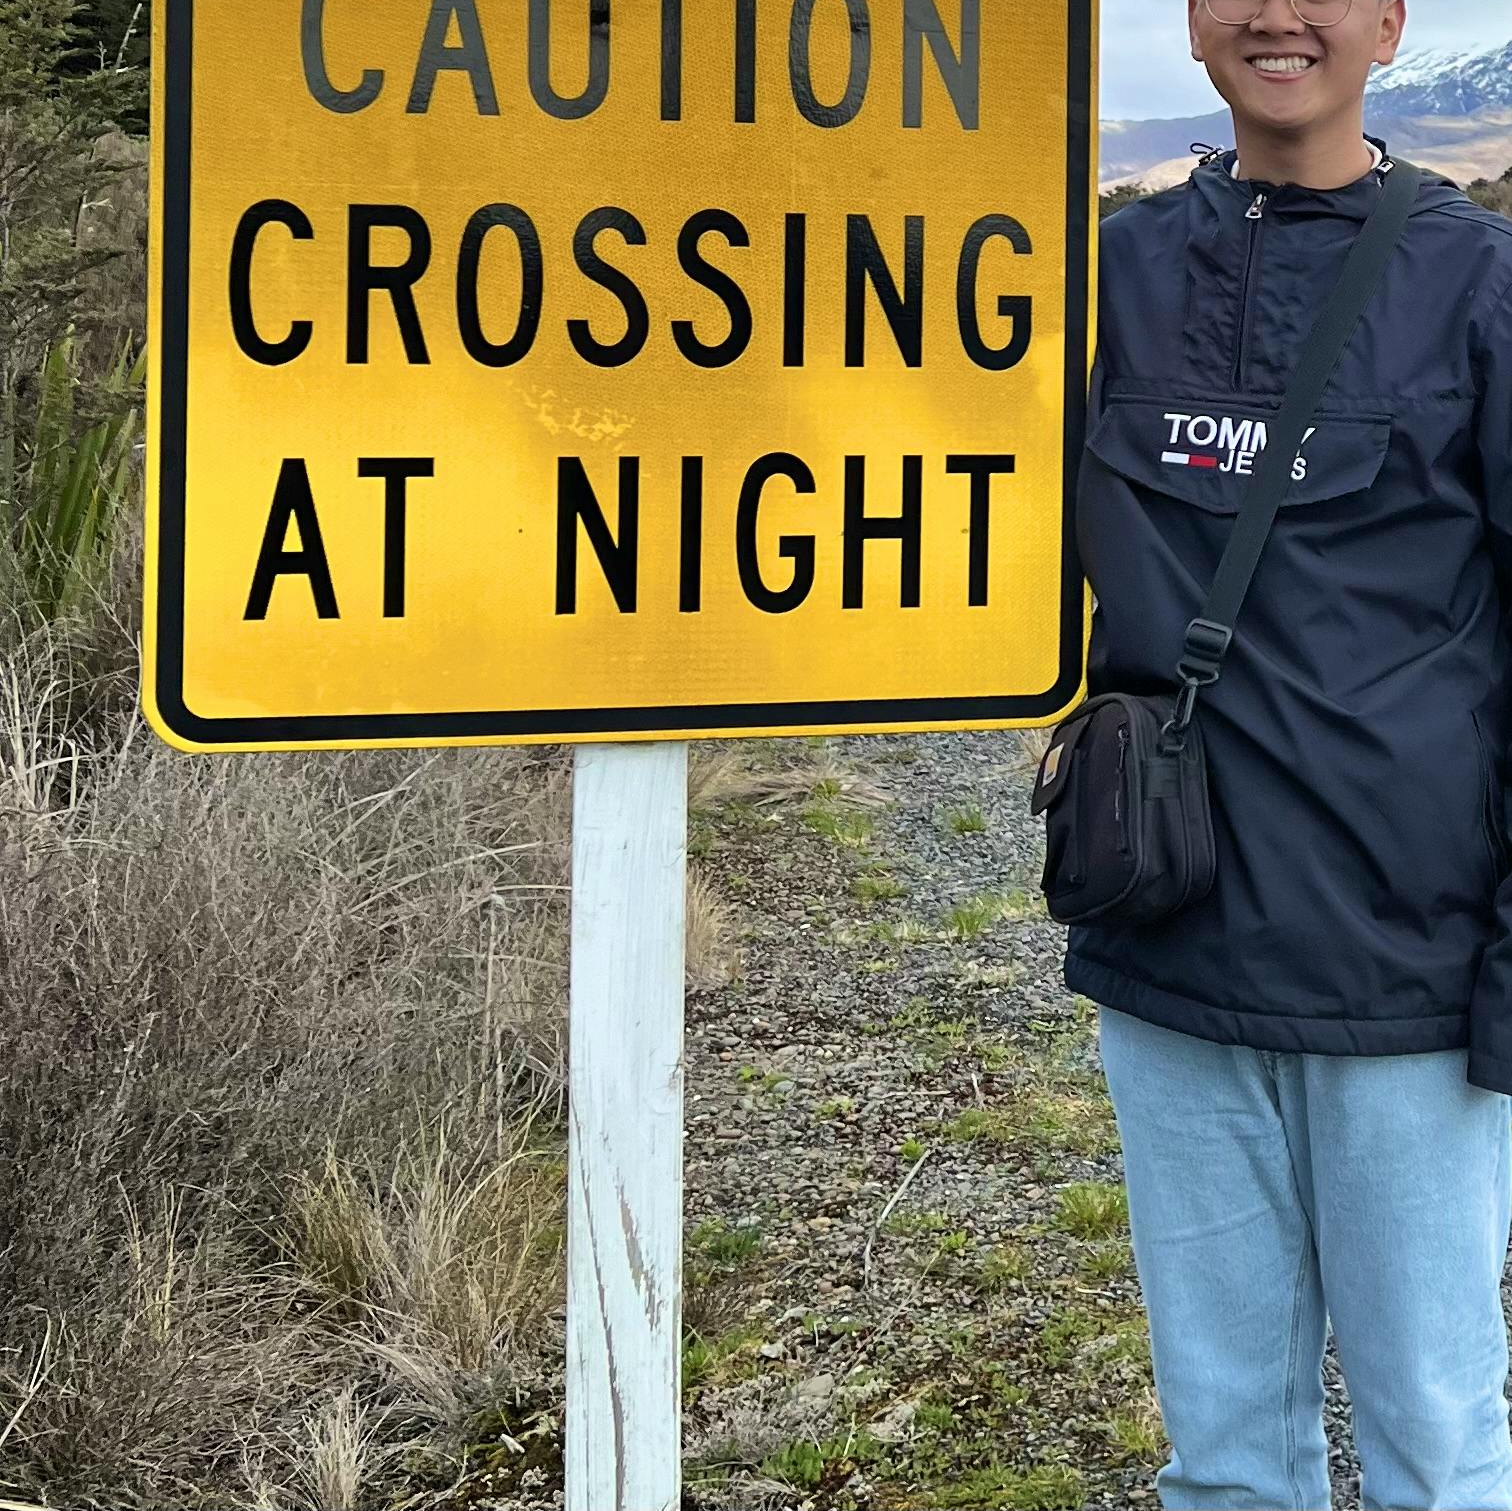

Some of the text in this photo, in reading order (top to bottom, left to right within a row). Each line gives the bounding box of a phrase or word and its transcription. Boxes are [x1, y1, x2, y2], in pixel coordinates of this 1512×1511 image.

[228, 198, 1033, 372] CROSSING
[243, 451, 1015, 621] AT NIGHT
[1218, 449, 1307, 481] JES
